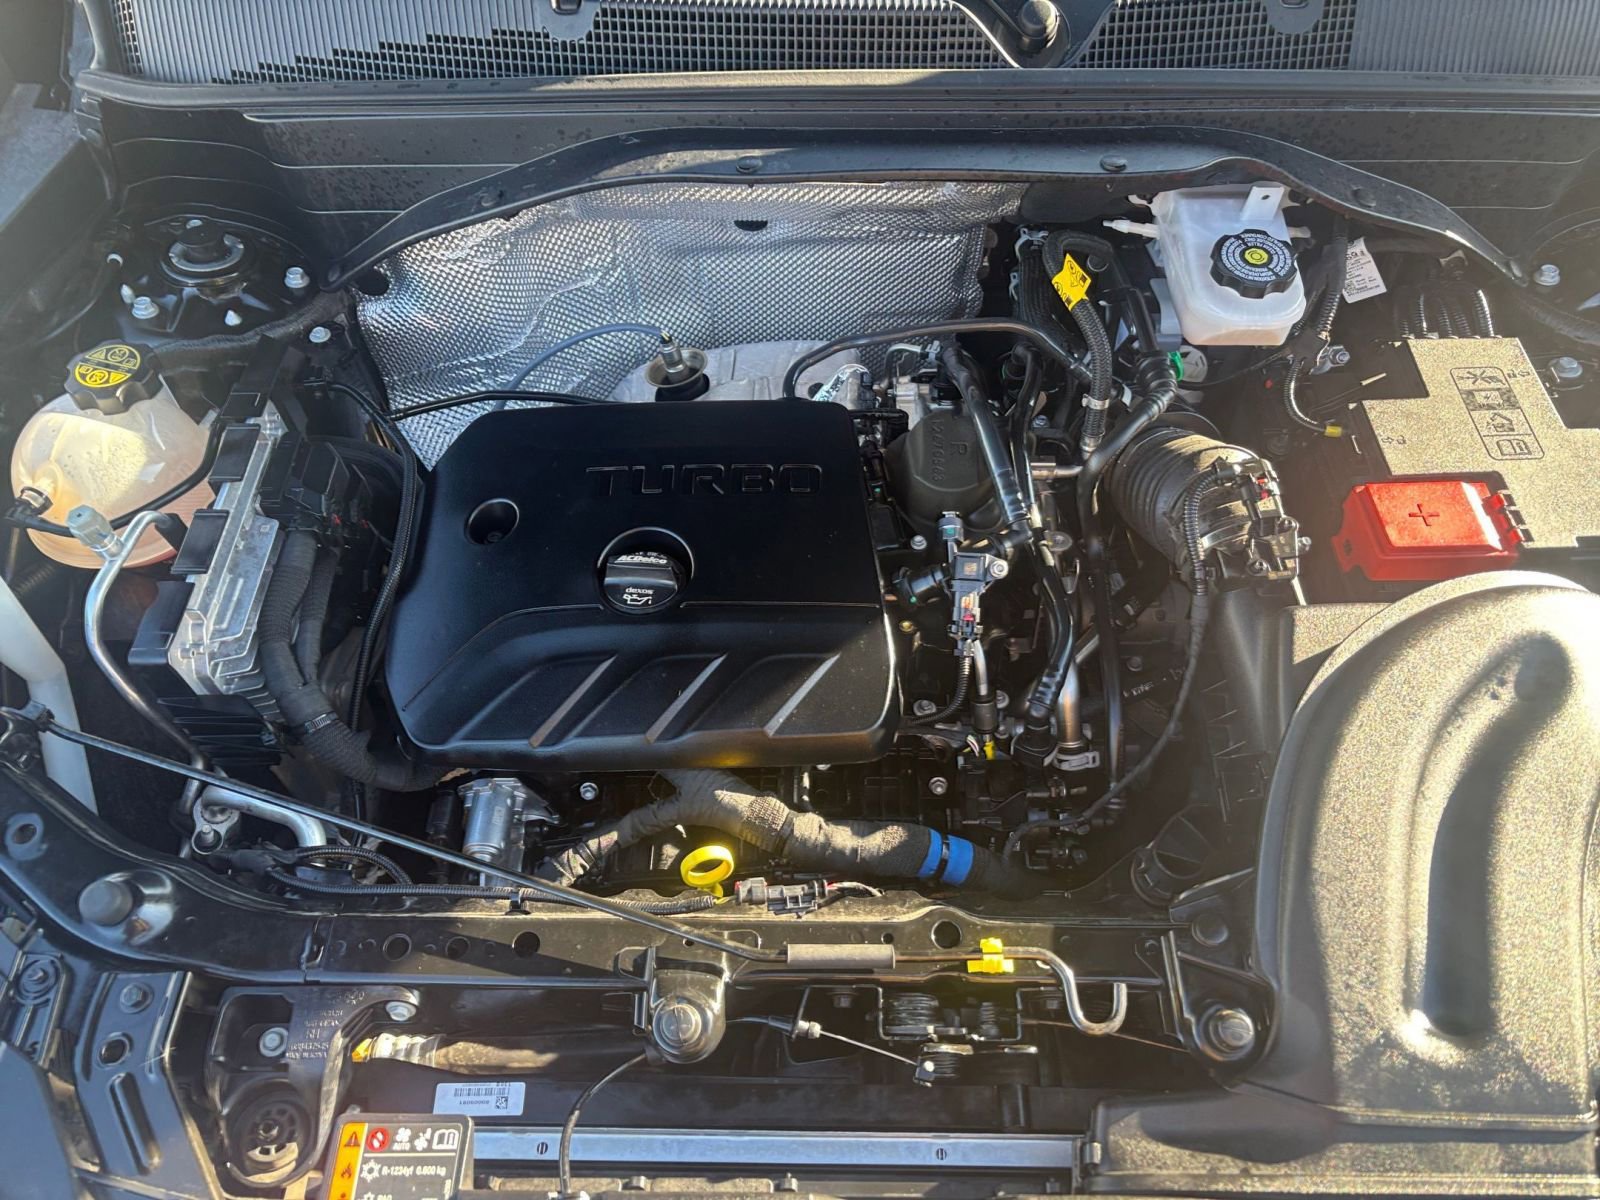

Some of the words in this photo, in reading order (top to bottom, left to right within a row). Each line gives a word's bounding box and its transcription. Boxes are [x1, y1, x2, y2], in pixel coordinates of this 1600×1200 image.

[585, 463, 823, 496] TURBO
[614, 554, 668, 564] ACDelco
[625, 586, 655, 594] dexos
[392, 1142, 410, 1151] AUTO
[436, 1165, 447, 1177] kg
